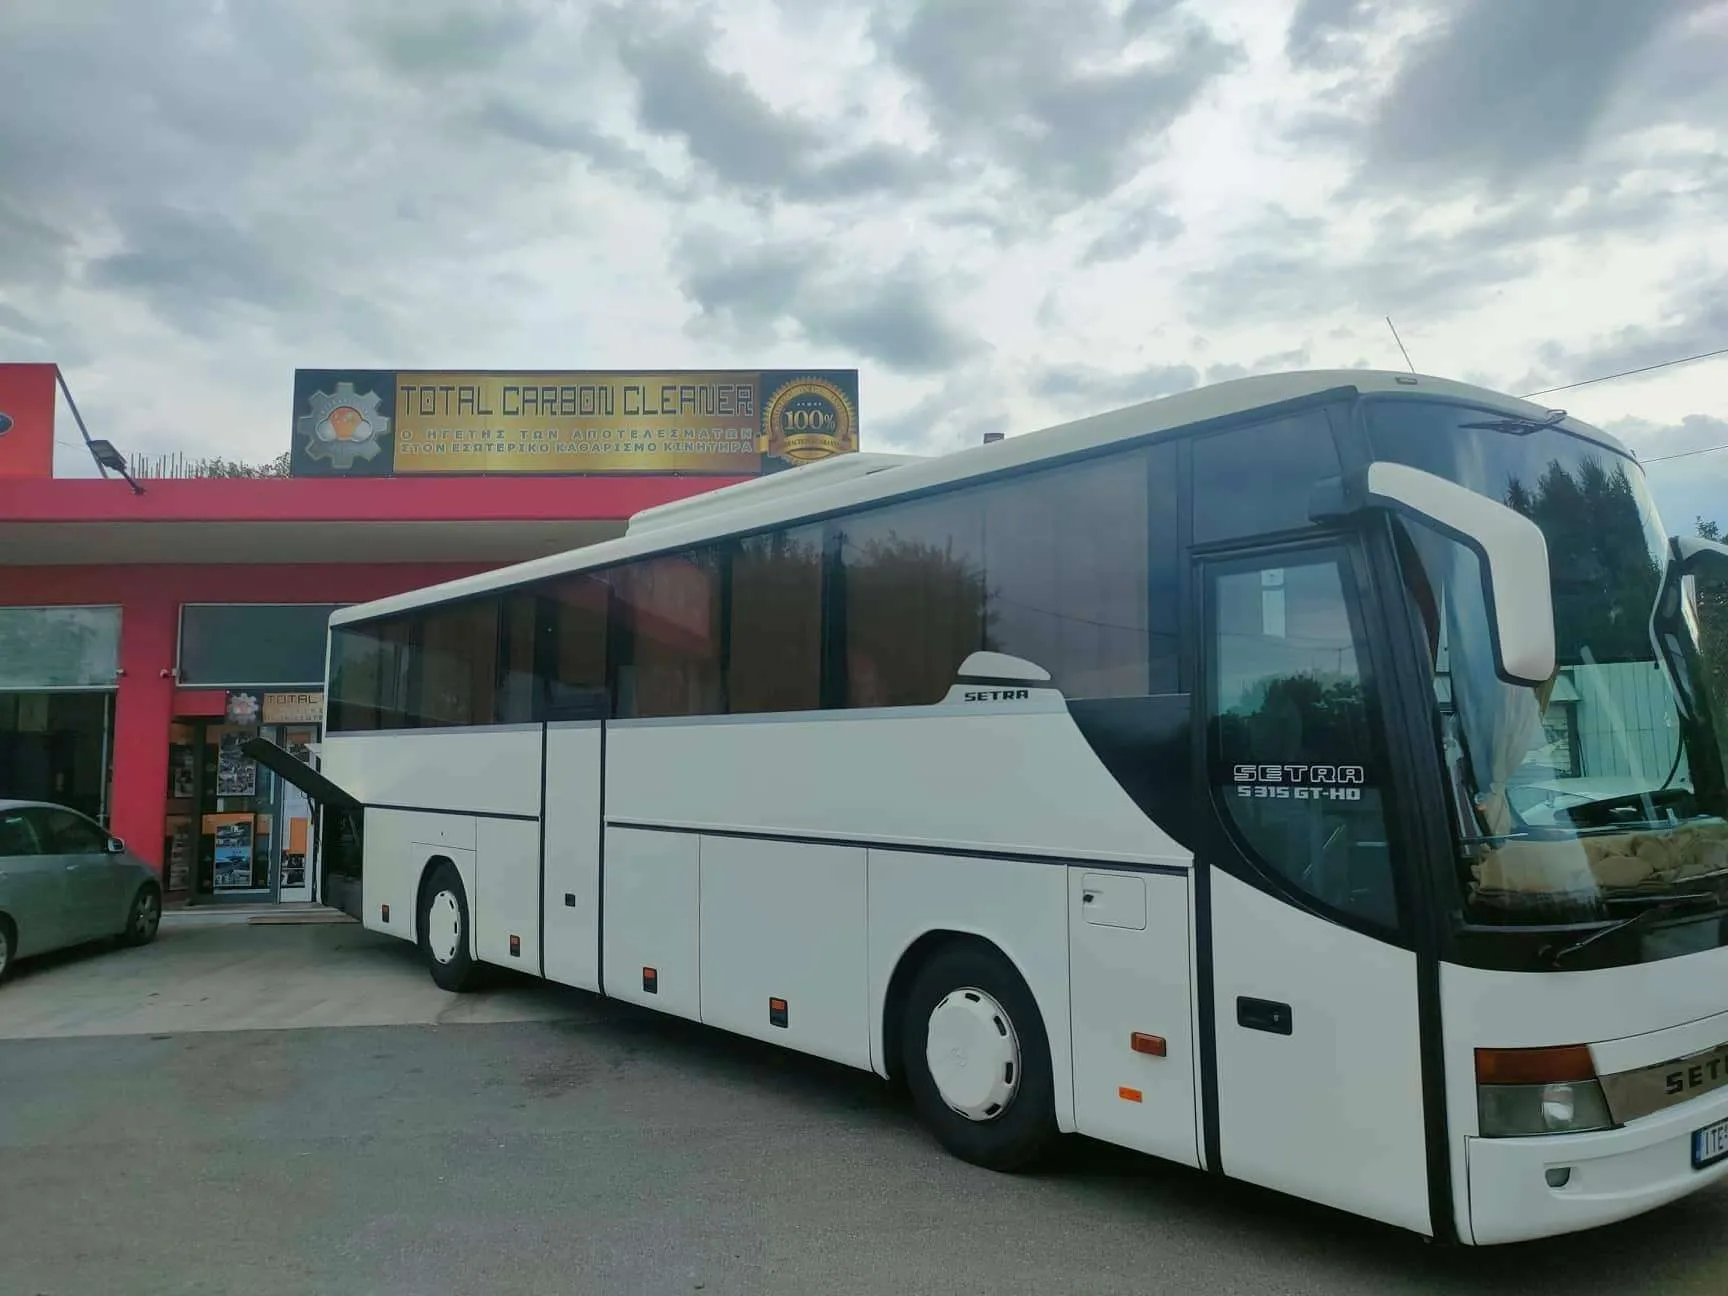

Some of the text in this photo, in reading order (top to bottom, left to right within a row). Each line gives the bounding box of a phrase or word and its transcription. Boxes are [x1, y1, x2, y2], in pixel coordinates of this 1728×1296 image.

[400, 385, 494, 416] TOTAL
[502, 385, 615, 416] CARBON
[623, 385, 753, 416] CLEANER
[784, 409, 836, 431] 100%
[401, 428, 753, 441] Ο ΗΓΕΤΗΣ ΤΩΝ ΑΠΟΤΕΛΕΣΜΑΤΩΝ
[401, 441, 754, 454] ΣΤΟΝ ΕΣΩΤΕΡΙΚΟ ΚΑΘΑΡΙΣΜΟ ΚΙΝΗΤΗΡΑ
[266, 694, 318, 704] TOTAL
[964, 689, 1029, 702] SETRA
[1233, 764, 1365, 784] SETRA
[1254, 786, 1290, 799] 315
[1294, 787, 1361, 801] GT-HD
[1665, 1055, 1728, 1094] SET
